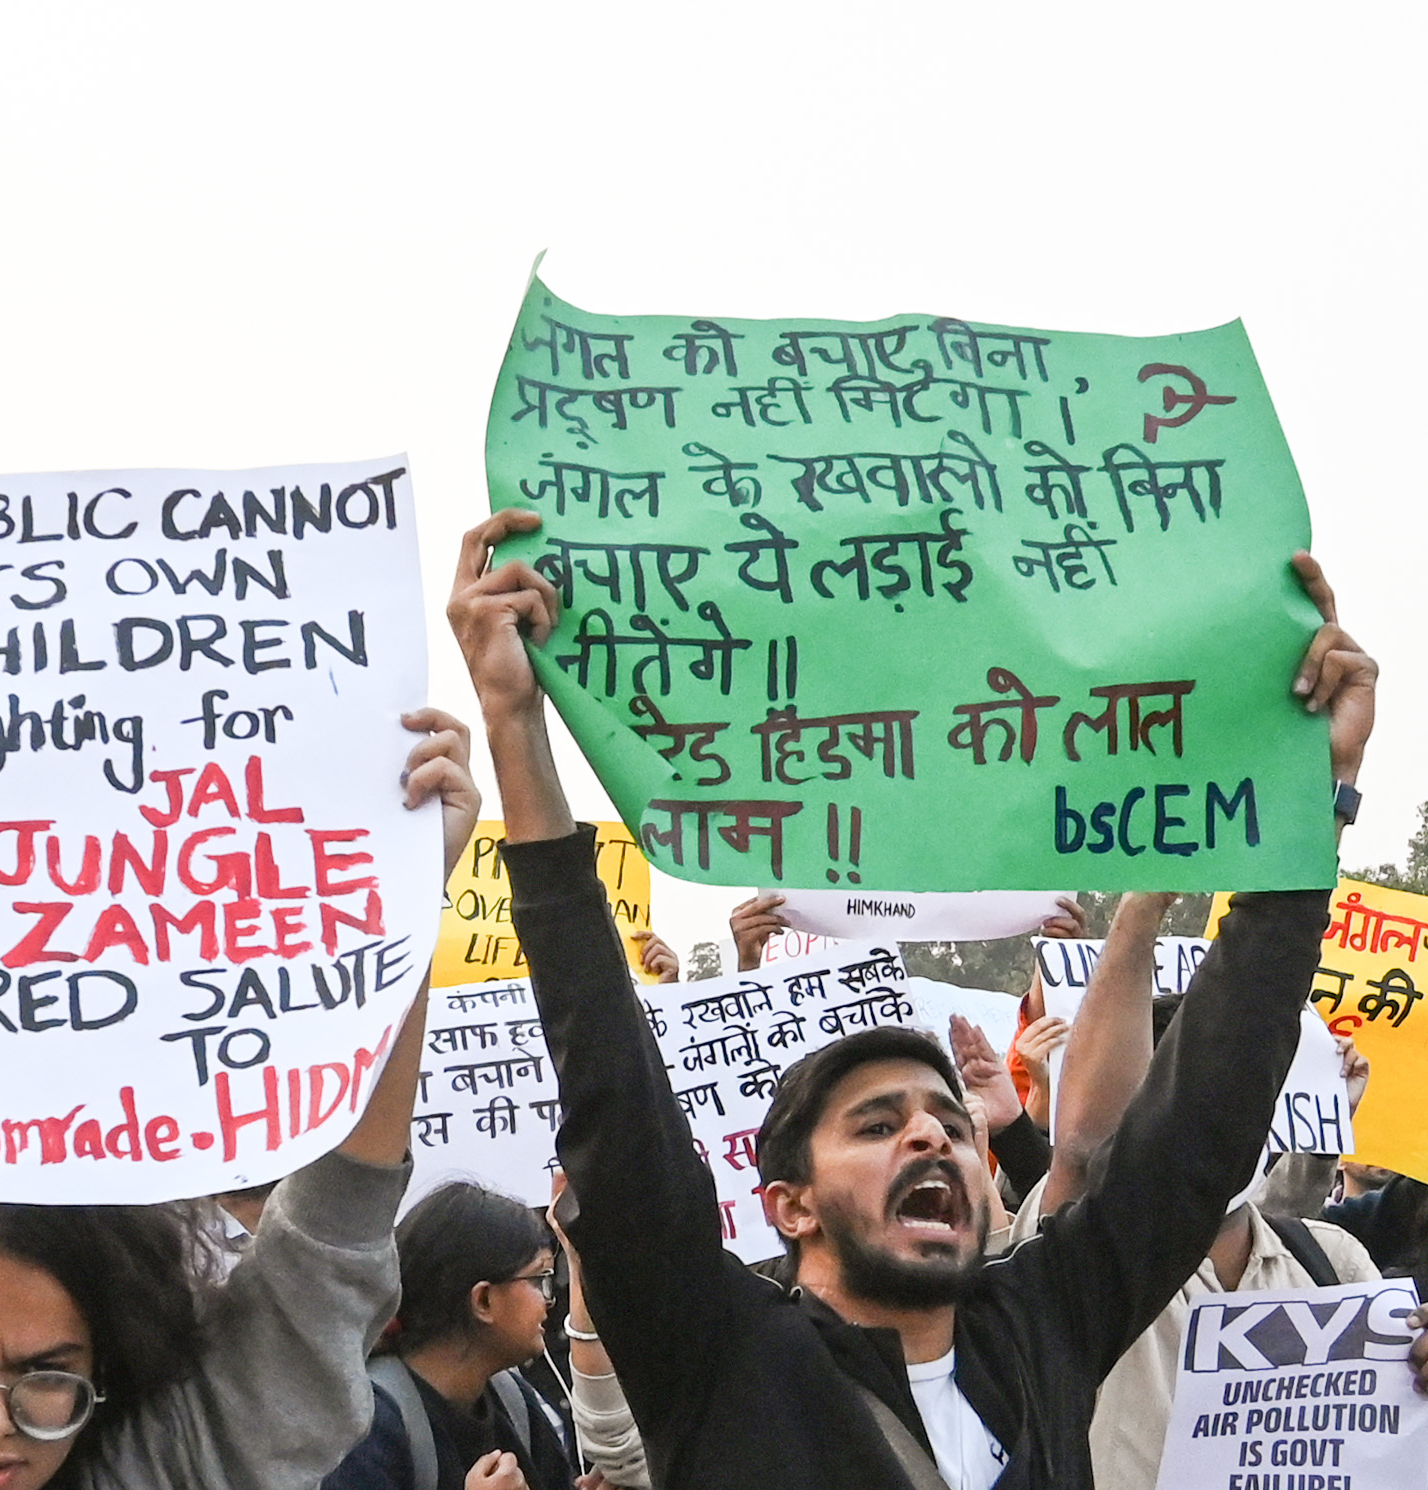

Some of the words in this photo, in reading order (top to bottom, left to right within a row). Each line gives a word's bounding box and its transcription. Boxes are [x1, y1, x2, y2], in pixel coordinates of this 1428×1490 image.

[663, 319, 745, 377] को
[772, 324, 919, 378] बचाए
[826, 358, 1032, 440] मिटेगा
[162, 467, 406, 540] CANNOT
[519, 452, 666, 519] जंगल
[681, 441, 762, 508] के
[1024, 440, 1092, 520] को
[1097, 443, 1227, 533] बिना
[106, 548, 292, 601] OWN
[534, 537, 711, 612] बचाए
[724, 512, 799, 604] ये
[809, 508, 974, 614] लड़ाई
[1012, 521, 1118, 593] नहीं
[181, 690, 294, 749] for
[947, 666, 1061, 766] को
[1063, 679, 1197, 761] लाल
[139, 756, 305, 829] JAL
[1054, 777, 1260, 857] bsCEM
[0, 889, 387, 969] ZAMEEN
[847, 899, 916, 919] HIMKHAND
[181, 934, 414, 1021] SALUTE
[681, 981, 774, 1029] रखवाले
[784, 969, 830, 1006] हम
[838, 948, 905, 993] सबके
[1358, 968, 1424, 1028] की
[160, 1027, 271, 1087] TO
[767, 1011, 807, 1049] को
[444, 1047, 545, 1096] बचाने
[473, 1096, 521, 1139] की
[1186, 1288, 1422, 1372] KYS
[1223, 1369, 1377, 1405] UNCHECKED
[1192, 1411, 1239, 1438] AIR
[1246, 1404, 1400, 1435] POLLUTION
[1239, 1441, 1262, 1467] IS
[1271, 1439, 1344, 1467] GOVT
